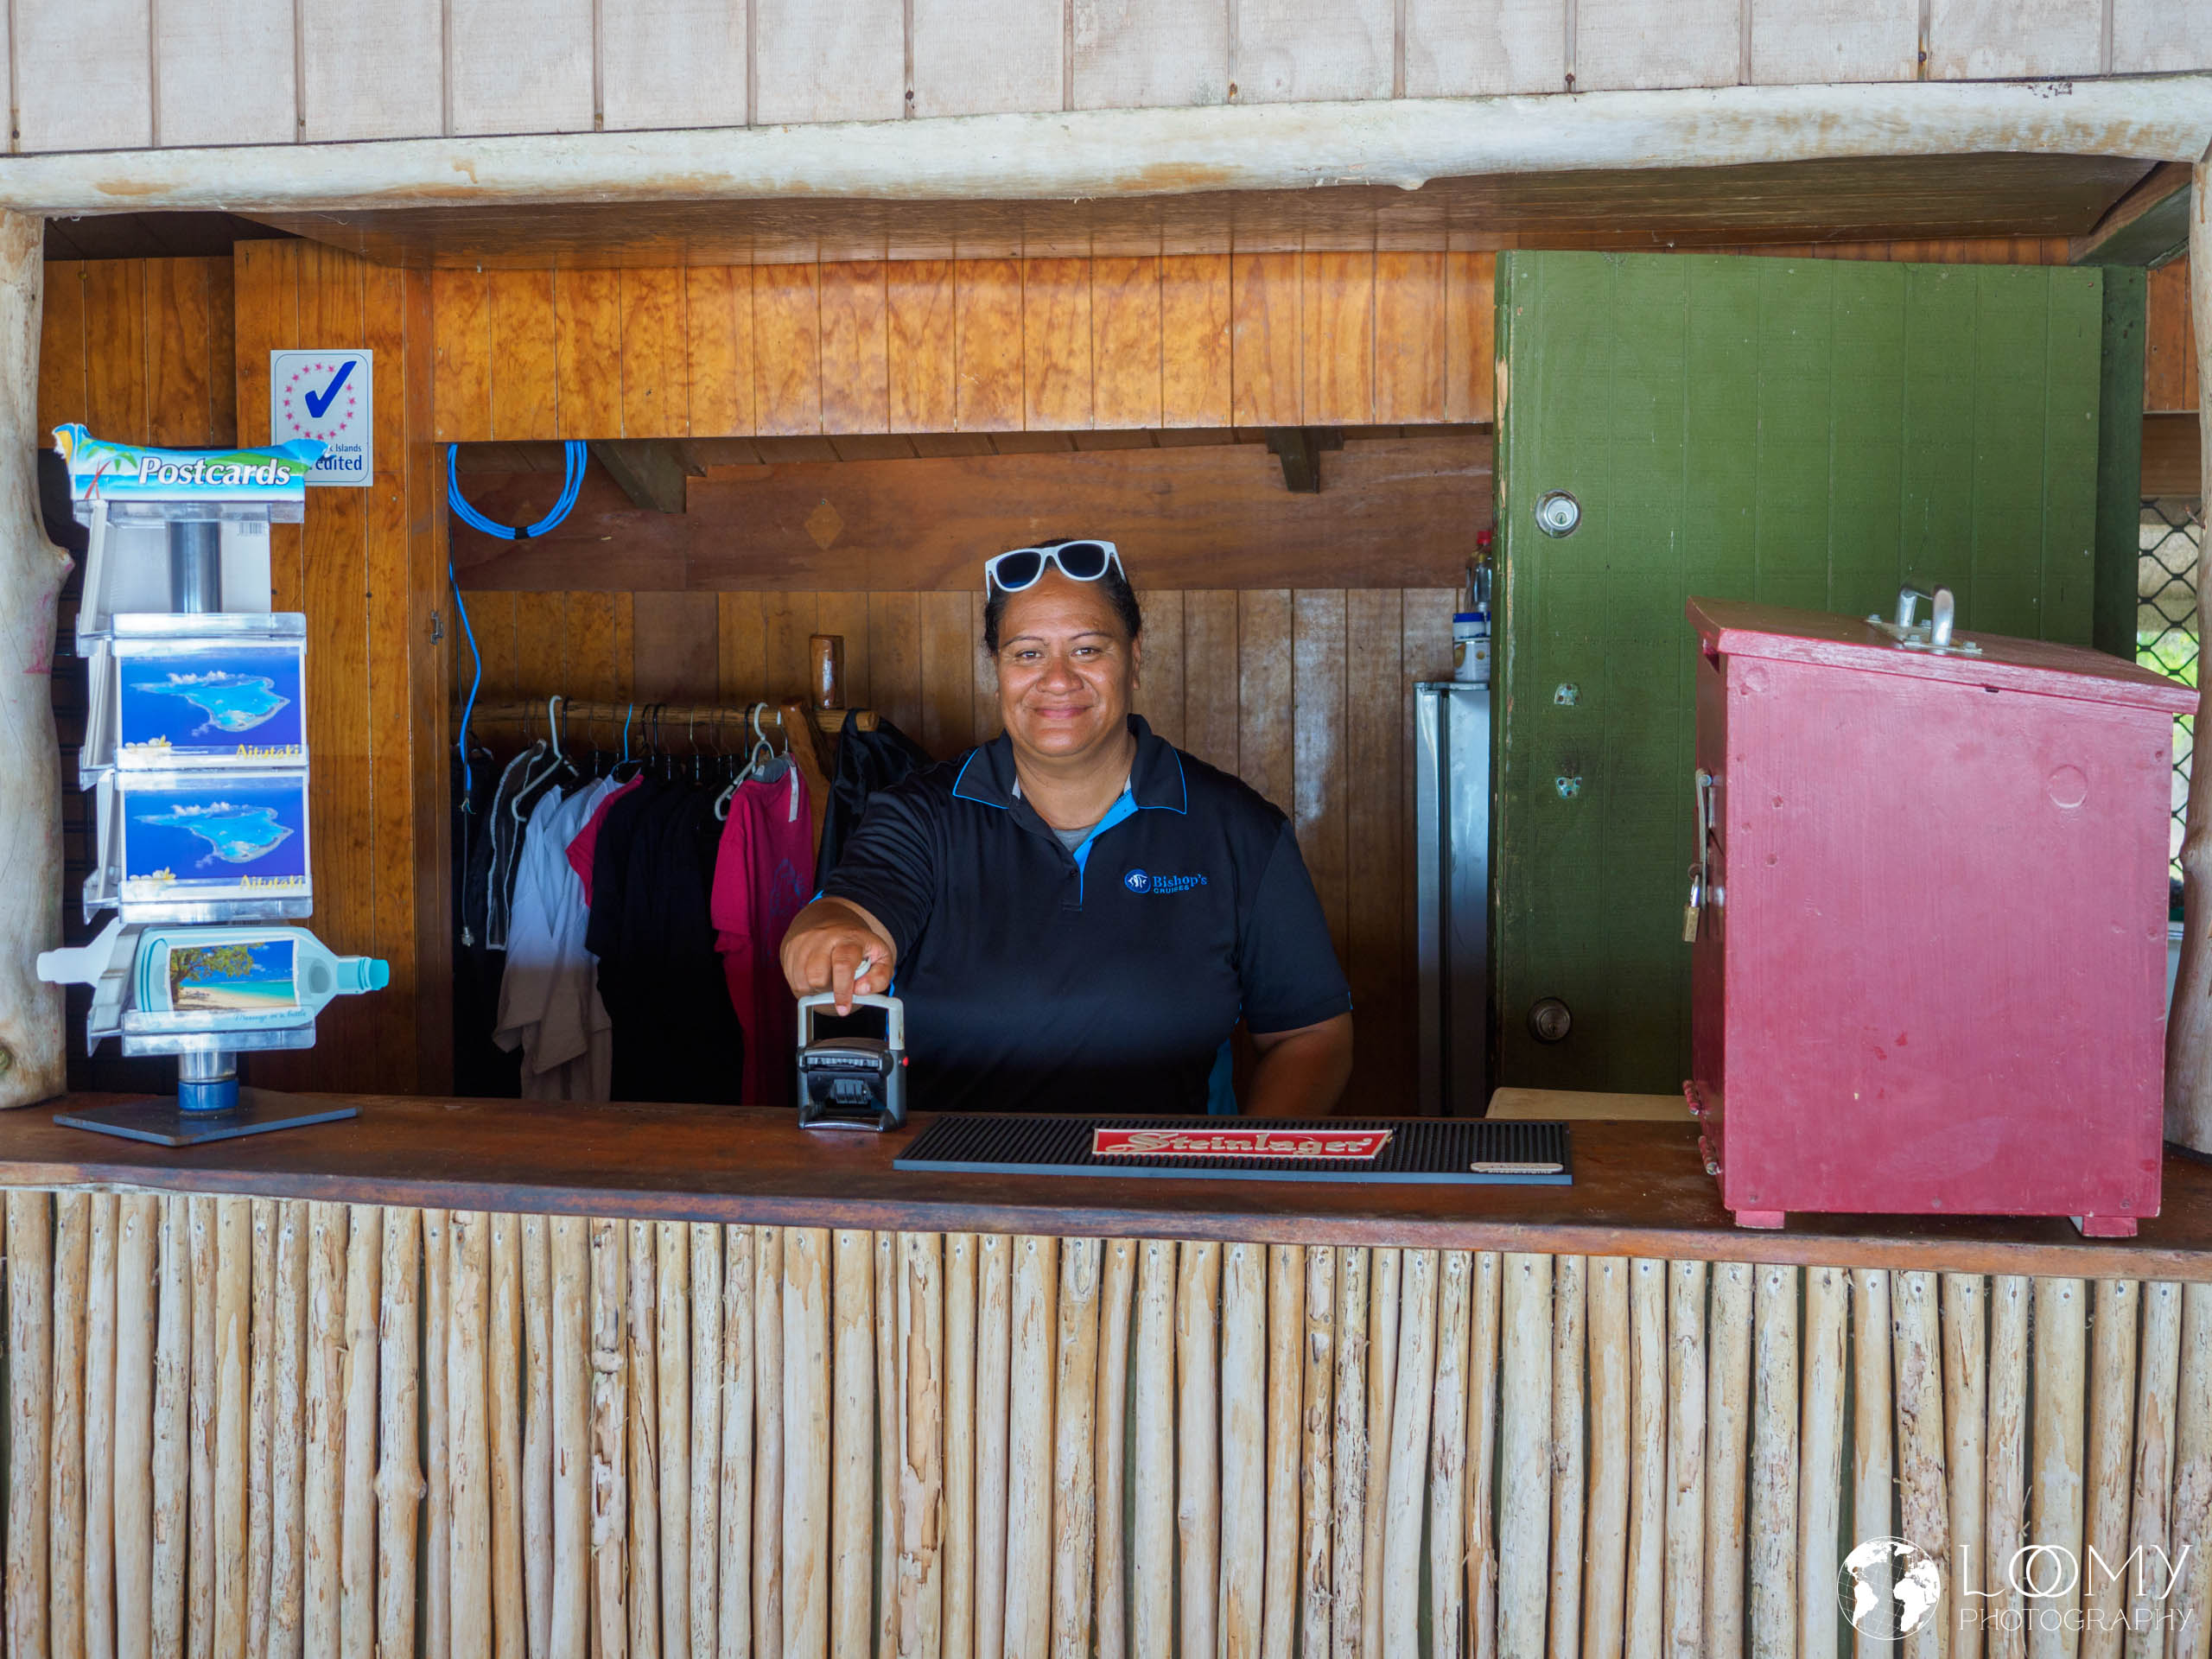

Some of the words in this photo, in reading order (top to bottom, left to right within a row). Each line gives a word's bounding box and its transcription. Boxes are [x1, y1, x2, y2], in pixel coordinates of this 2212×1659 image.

[335, 443, 362, 453] Islands
[309, 454, 362, 471] edited
[138, 456, 290, 486] Postcards
[236, 744, 299, 760] Aitutaki
[239, 874, 304, 890] Aitutaki
[1152, 874, 1209, 887] Bishop's
[1154, 885, 1190, 894] CRUISES
[1105, 1133, 1373, 1156] Steinlager
